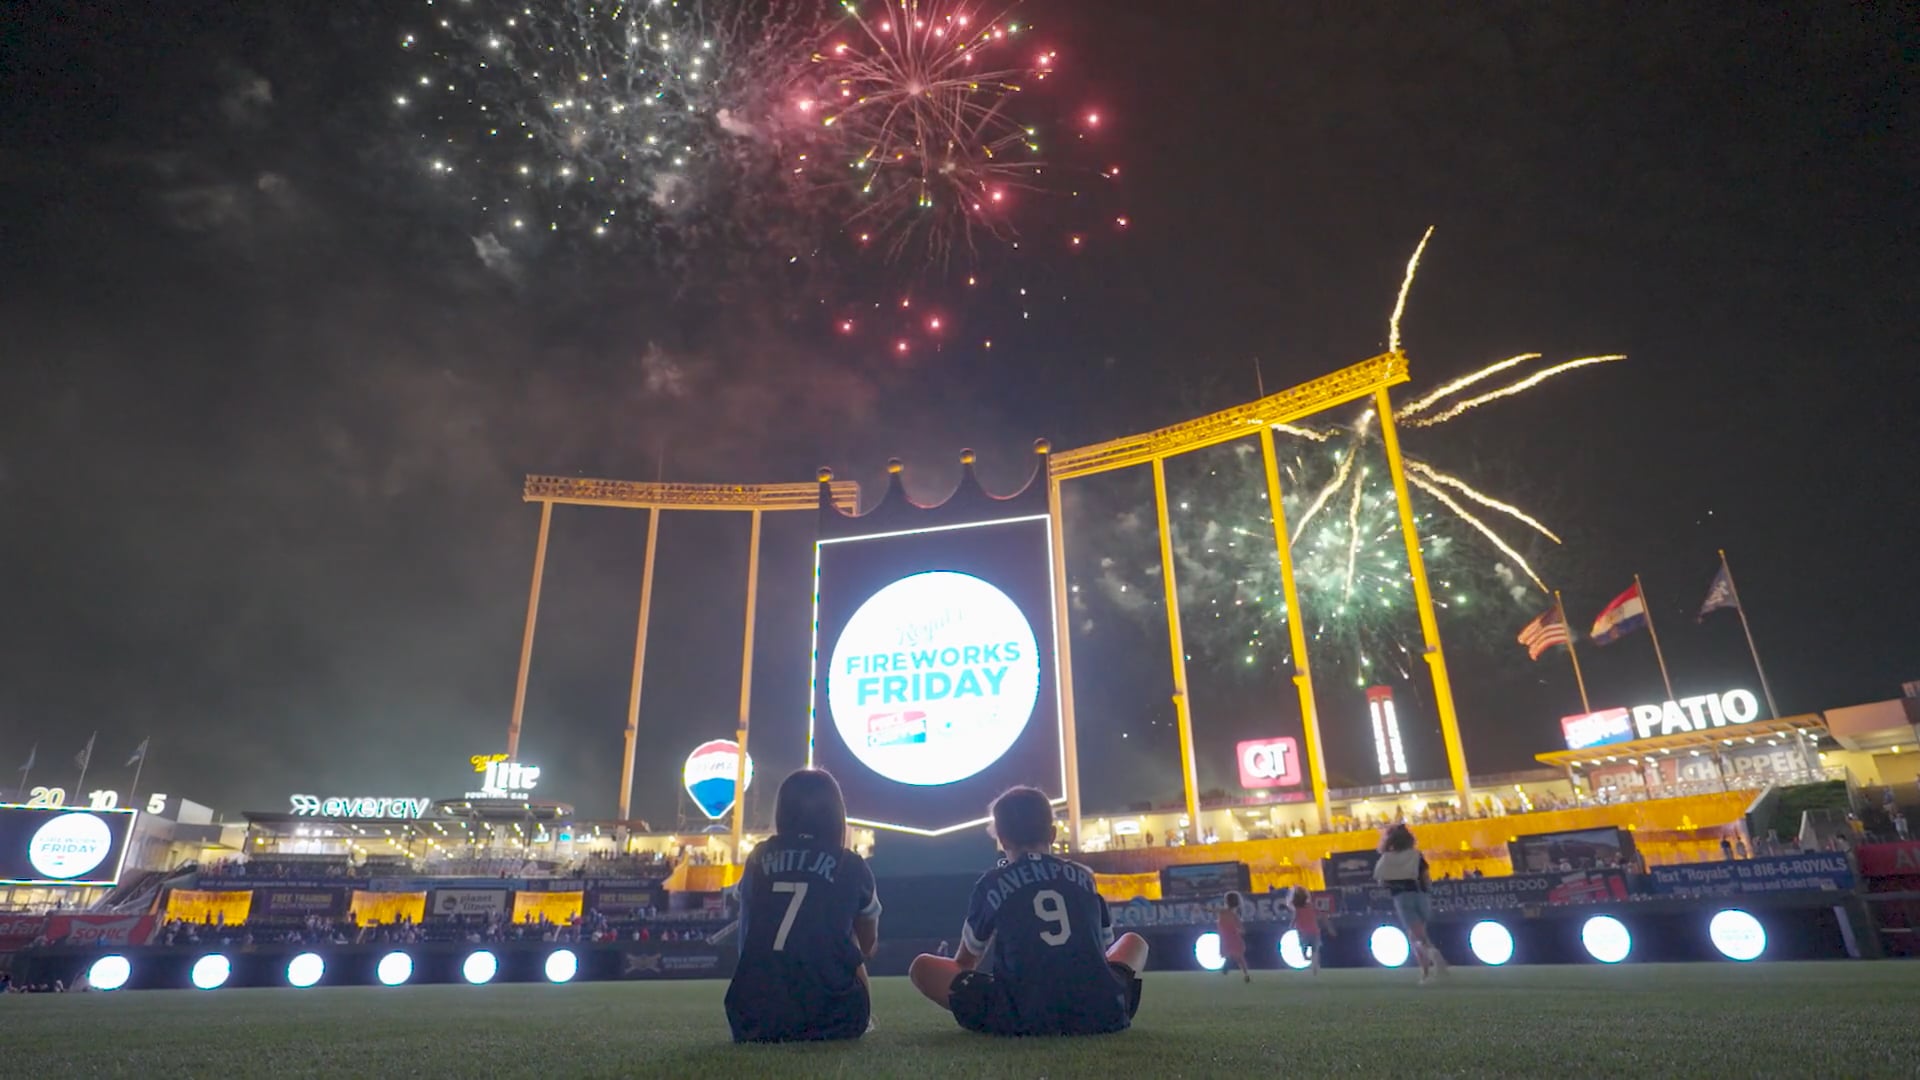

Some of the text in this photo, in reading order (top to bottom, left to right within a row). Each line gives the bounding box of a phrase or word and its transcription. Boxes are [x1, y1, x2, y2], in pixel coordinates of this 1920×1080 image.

[846, 641, 1021, 675] FIREWORKS
[857, 666, 1009, 706] FRIDAY
[1632, 688, 1759, 739] PATIO
[1243, 743, 1288, 779] QT
[481, 761, 540, 793] Lite
[27, 786, 167, 814] 20 10 5
[40, 843, 97, 853] FRIDAY
[762, 849, 810, 876] WITT
[1654, 870, 1681, 883] Text
[1737, 866, 1751, 878] to
[460, 893, 492, 904] planet
[1461, 880, 1506, 894] FRESH
[1508, 878, 1549, 891] FOOD
[1467, 892, 1518, 908] DRINKS
[772, 881, 808, 951] 7
[1033, 889, 1071, 946] 9
[1111, 898, 1292, 927] FOUNTAI DEC
[72, 926, 127, 940] SONIC
